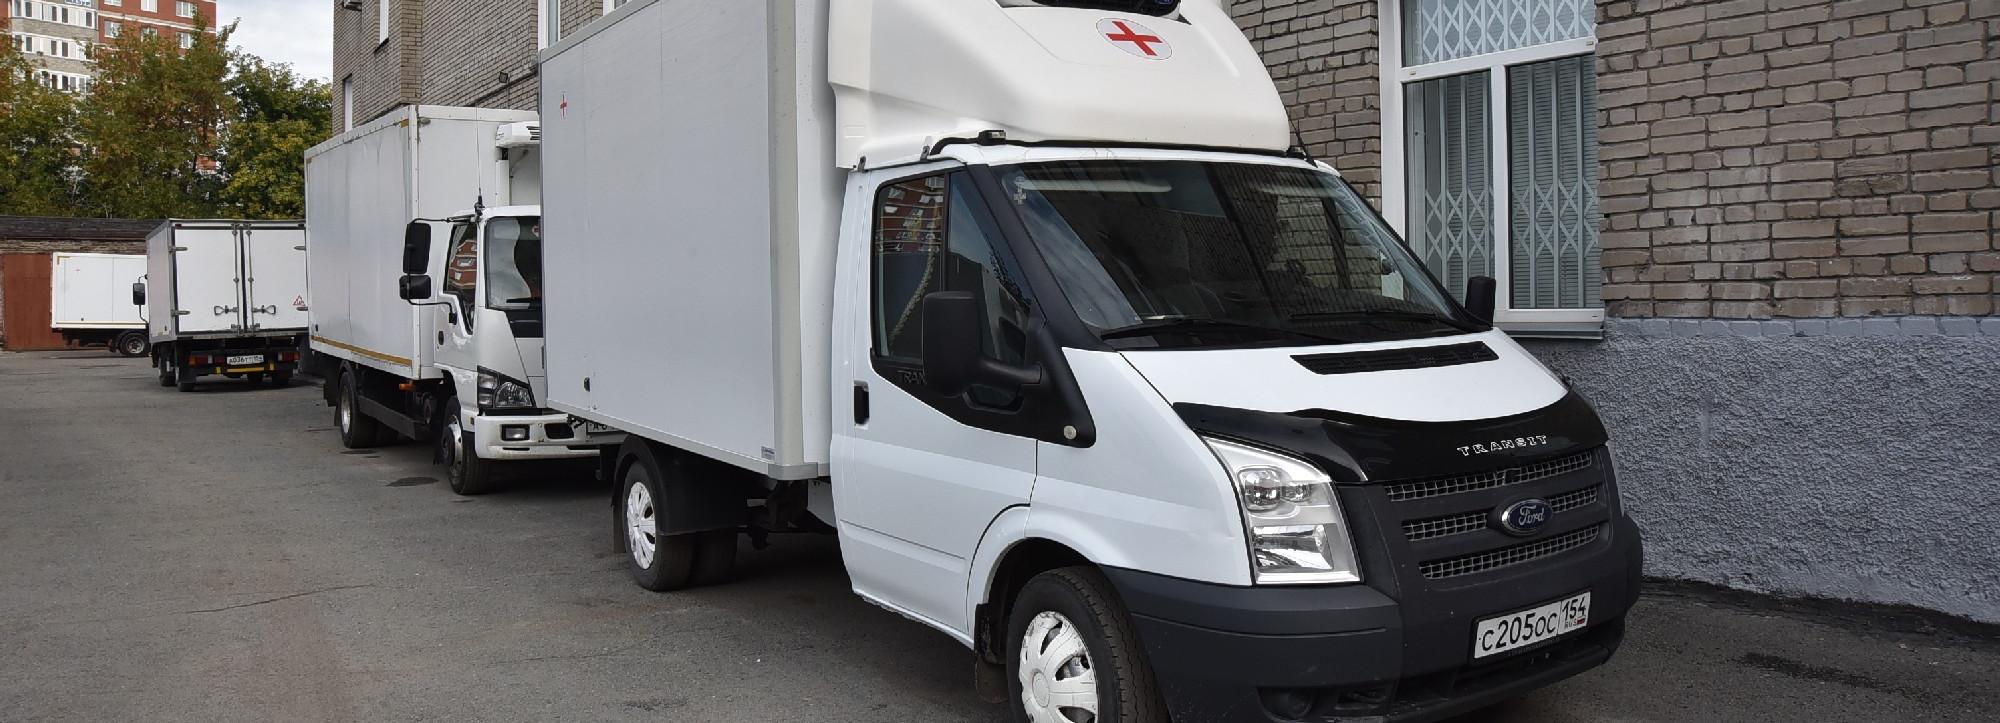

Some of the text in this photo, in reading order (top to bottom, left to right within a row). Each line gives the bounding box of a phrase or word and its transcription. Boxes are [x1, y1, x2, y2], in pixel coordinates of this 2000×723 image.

[1457, 435, 1546, 456] TRANSIT
[1518, 504, 1545, 526] Ford
[1562, 596, 1586, 621] 154
[1564, 618, 1577, 629] RUS
